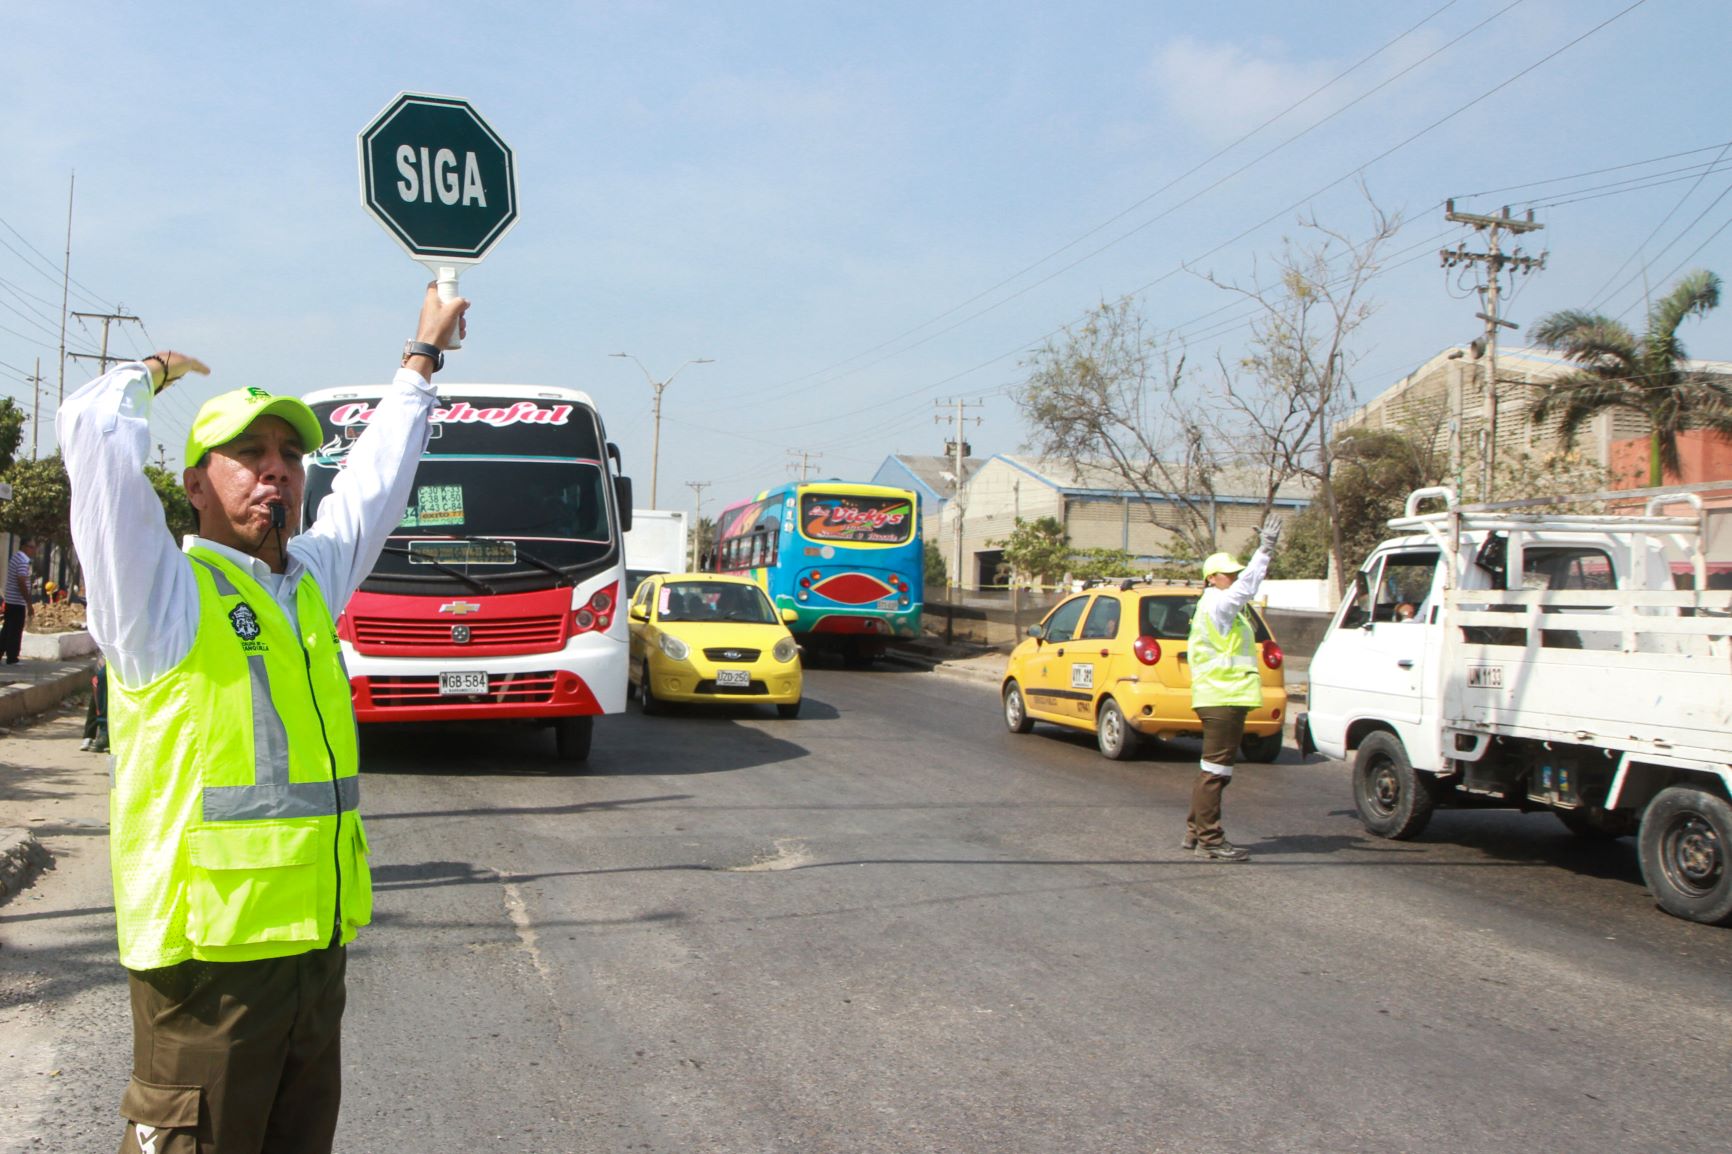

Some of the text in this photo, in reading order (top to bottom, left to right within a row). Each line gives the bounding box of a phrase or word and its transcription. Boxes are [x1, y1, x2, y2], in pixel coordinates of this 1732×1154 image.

[396, 144, 487, 208] SIGA
[420, 495, 461, 504] C-38 K-50
[442, 672, 486, 688] WGB-584
